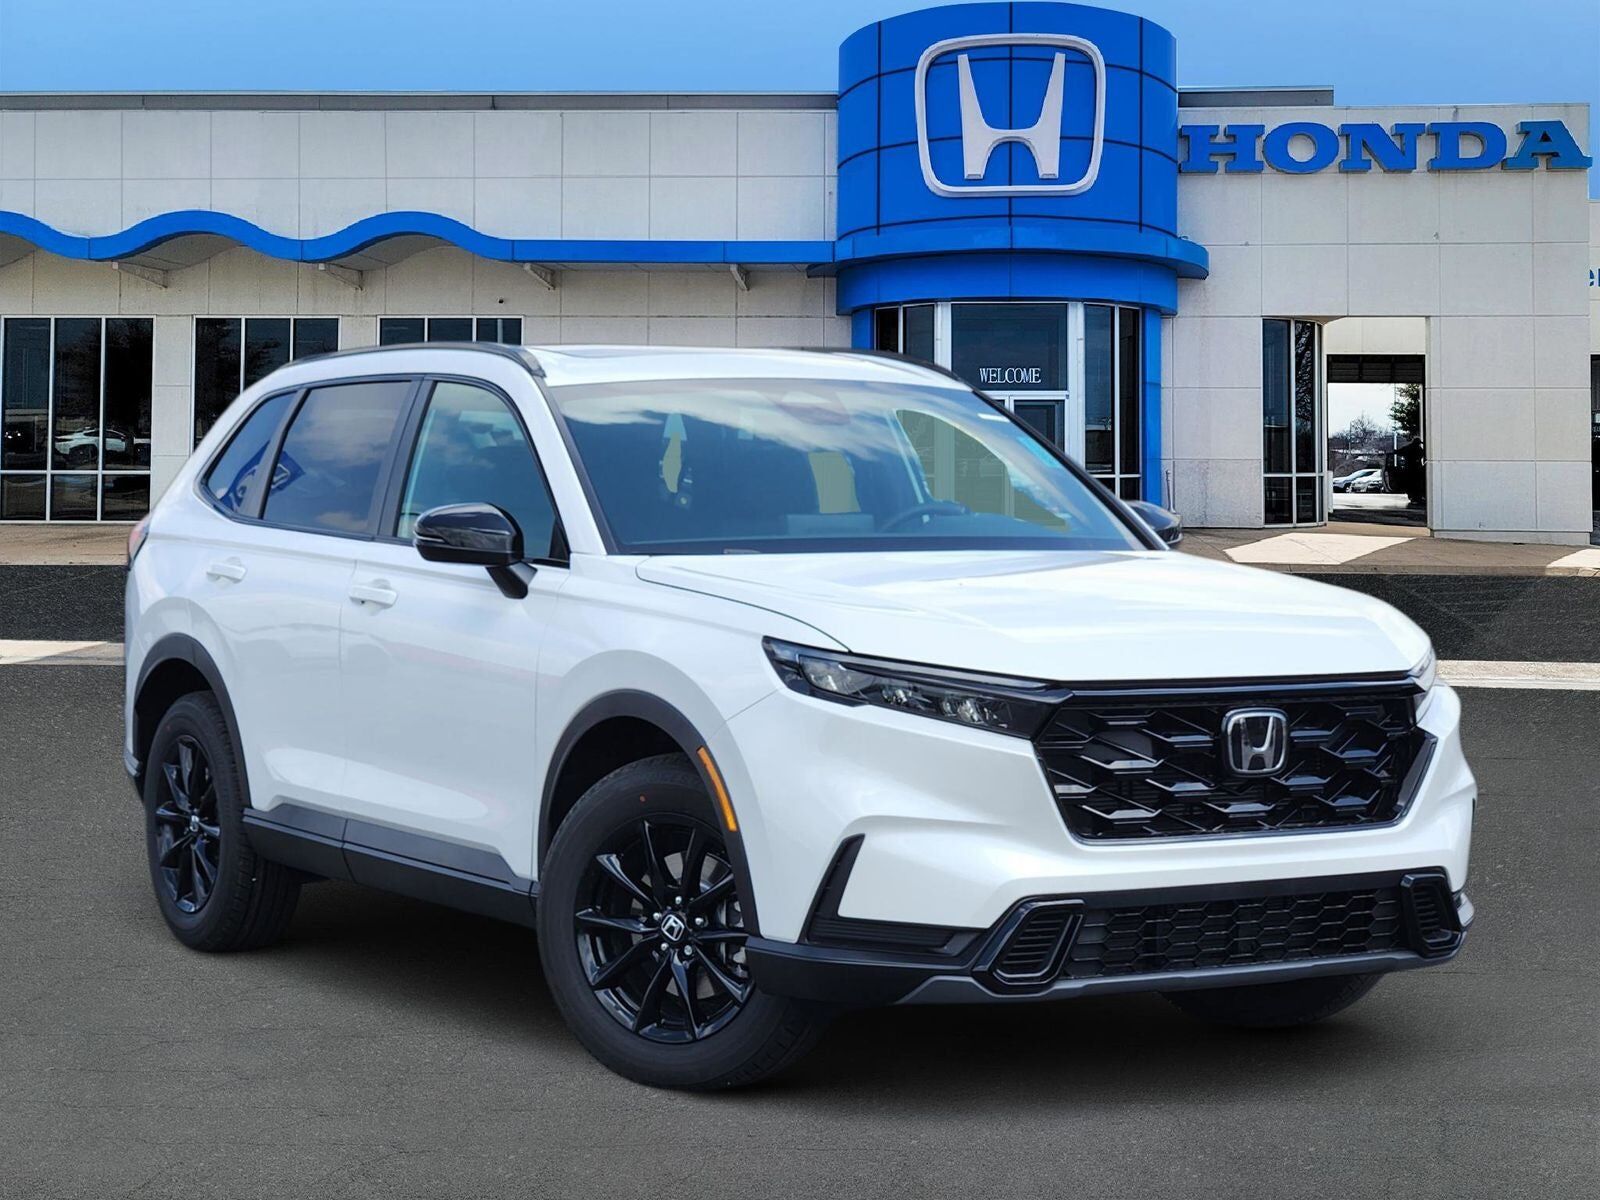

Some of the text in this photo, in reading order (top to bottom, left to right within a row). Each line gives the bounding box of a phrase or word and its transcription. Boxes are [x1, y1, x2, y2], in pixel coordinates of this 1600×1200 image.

[957, 52, 1066, 179] H
[1178, 121, 1592, 173] HONDA
[979, 367, 1042, 384] WELCOME
